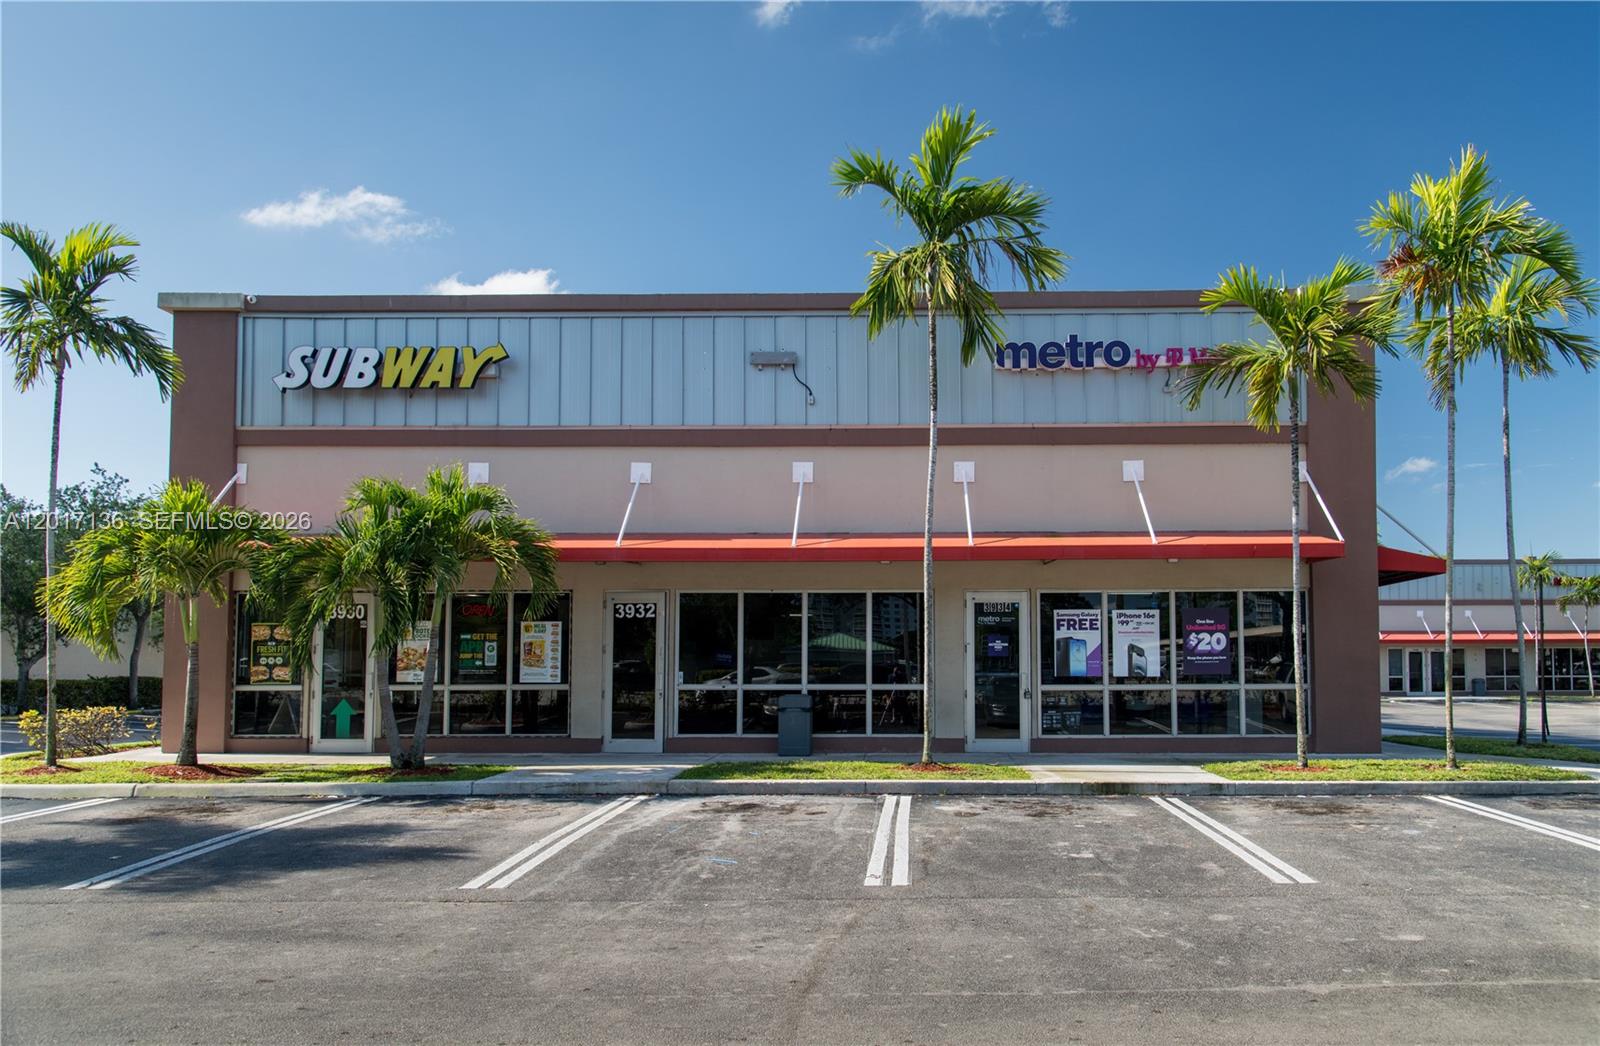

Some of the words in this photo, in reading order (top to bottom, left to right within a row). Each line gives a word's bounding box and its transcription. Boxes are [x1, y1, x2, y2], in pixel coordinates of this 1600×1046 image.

[996, 334, 1131, 370] metro
[1135, 348, 1161, 373] by
[272, 341, 510, 392] SUBWAY
[462, 604, 495, 616] OPEN
[615, 603, 656, 619] 3932
[983, 601, 1012, 613] 3934
[978, 615, 1000, 623] metro
[1056, 618, 1100, 631] FREE
[1189, 631, 1228, 651] $20
[256, 645, 277, 653] FRESH
